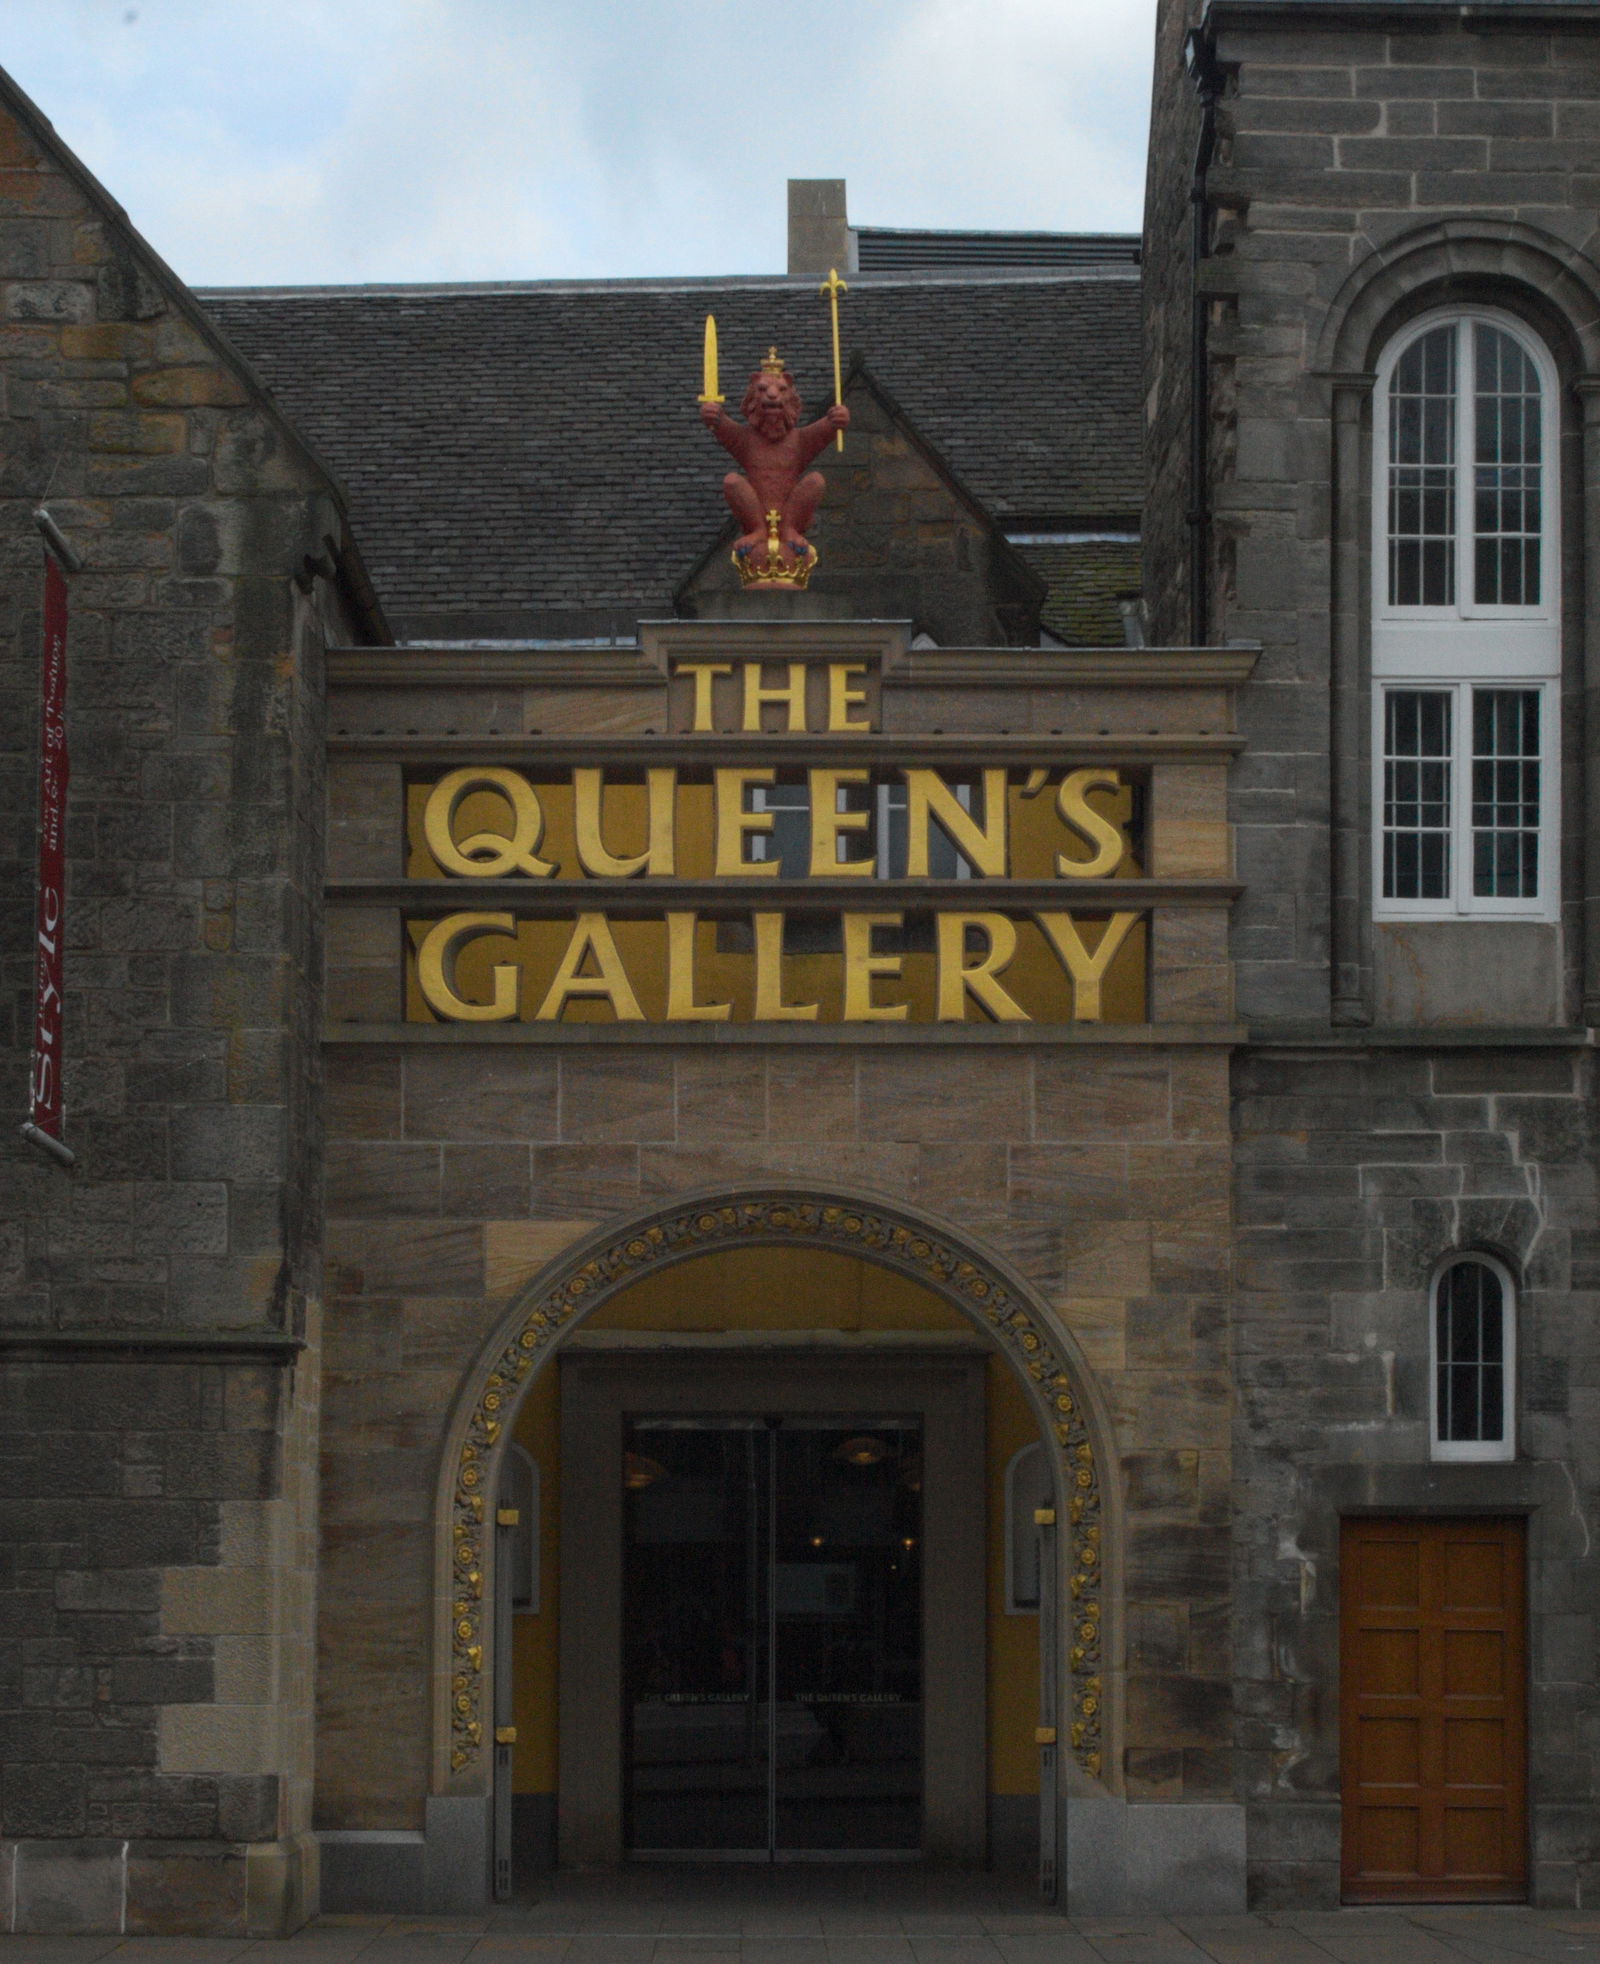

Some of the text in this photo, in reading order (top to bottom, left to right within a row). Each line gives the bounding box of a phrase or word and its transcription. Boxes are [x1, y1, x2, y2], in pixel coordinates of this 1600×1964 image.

[674, 663, 872, 732] THE
[423, 766, 1130, 880] QUEEN'S
[36, 887, 60, 1111] Style
[414, 910, 1144, 1022] GALLERY
